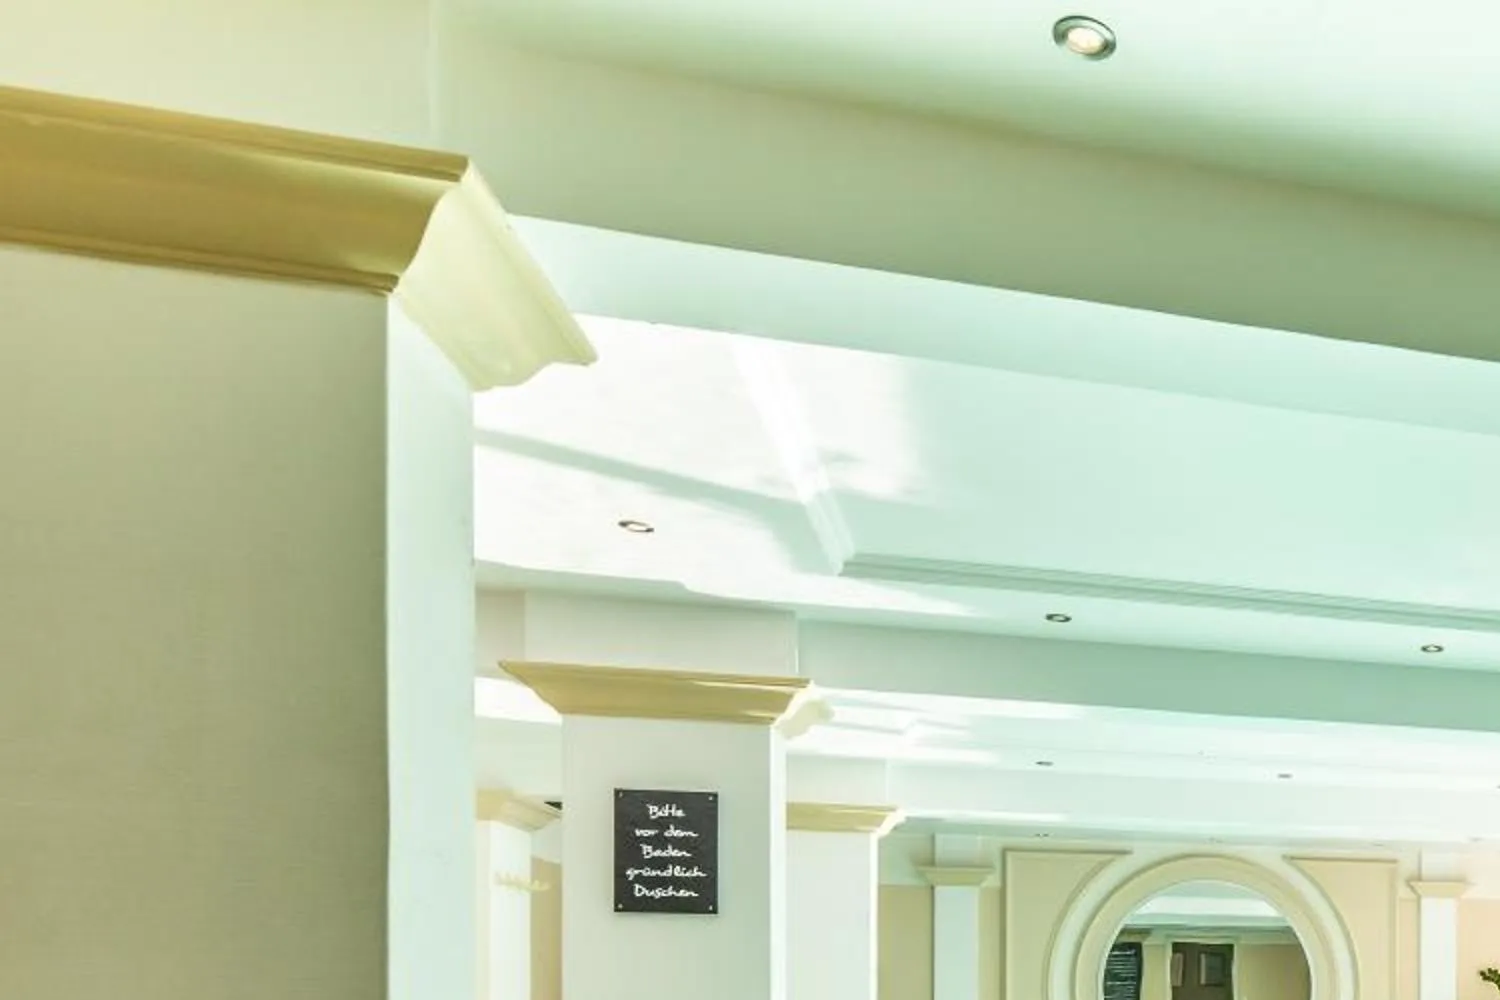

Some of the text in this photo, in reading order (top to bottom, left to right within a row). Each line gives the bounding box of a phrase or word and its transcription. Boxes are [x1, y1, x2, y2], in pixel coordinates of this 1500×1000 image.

[646, 803, 686, 819] Bitte
[634, 824, 699, 837] vor dem
[640, 844, 692, 859] Baden
[625, 864, 708, 881] gründlich
[633, 884, 699, 899] Duschen
